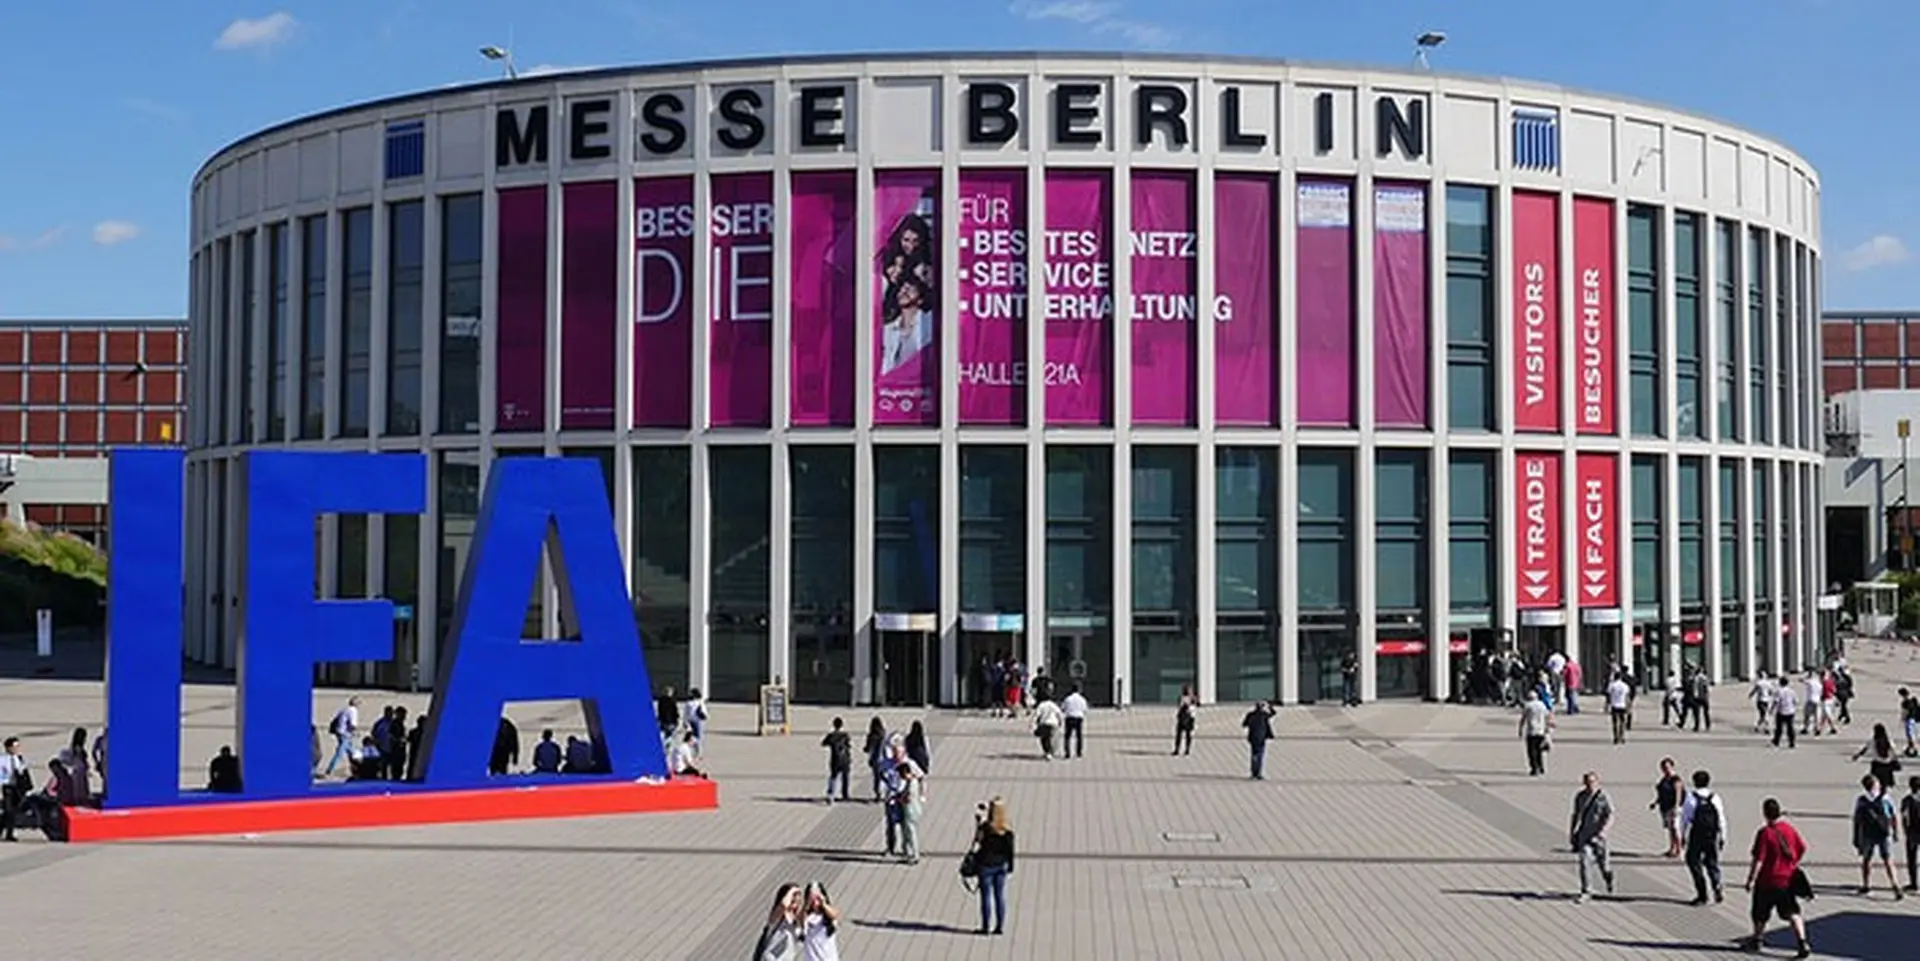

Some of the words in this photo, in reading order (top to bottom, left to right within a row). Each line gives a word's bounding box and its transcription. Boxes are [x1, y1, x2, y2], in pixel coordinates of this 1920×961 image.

[498, 86, 846, 166] MESSE
[966, 83, 1423, 157] BERLIN
[958, 194, 1009, 224] FÜR
[1129, 231, 1196, 256] NETZ
[958, 361, 1025, 385] HALLE
[1043, 361, 1082, 386] 21A
[1524, 262, 1545, 407] VISITORS
[1583, 267, 1602, 425] BESUCHER
[1526, 459, 1546, 564] TRADE
[1586, 479, 1604, 565] FACH
[102, 447, 668, 809] IFA
